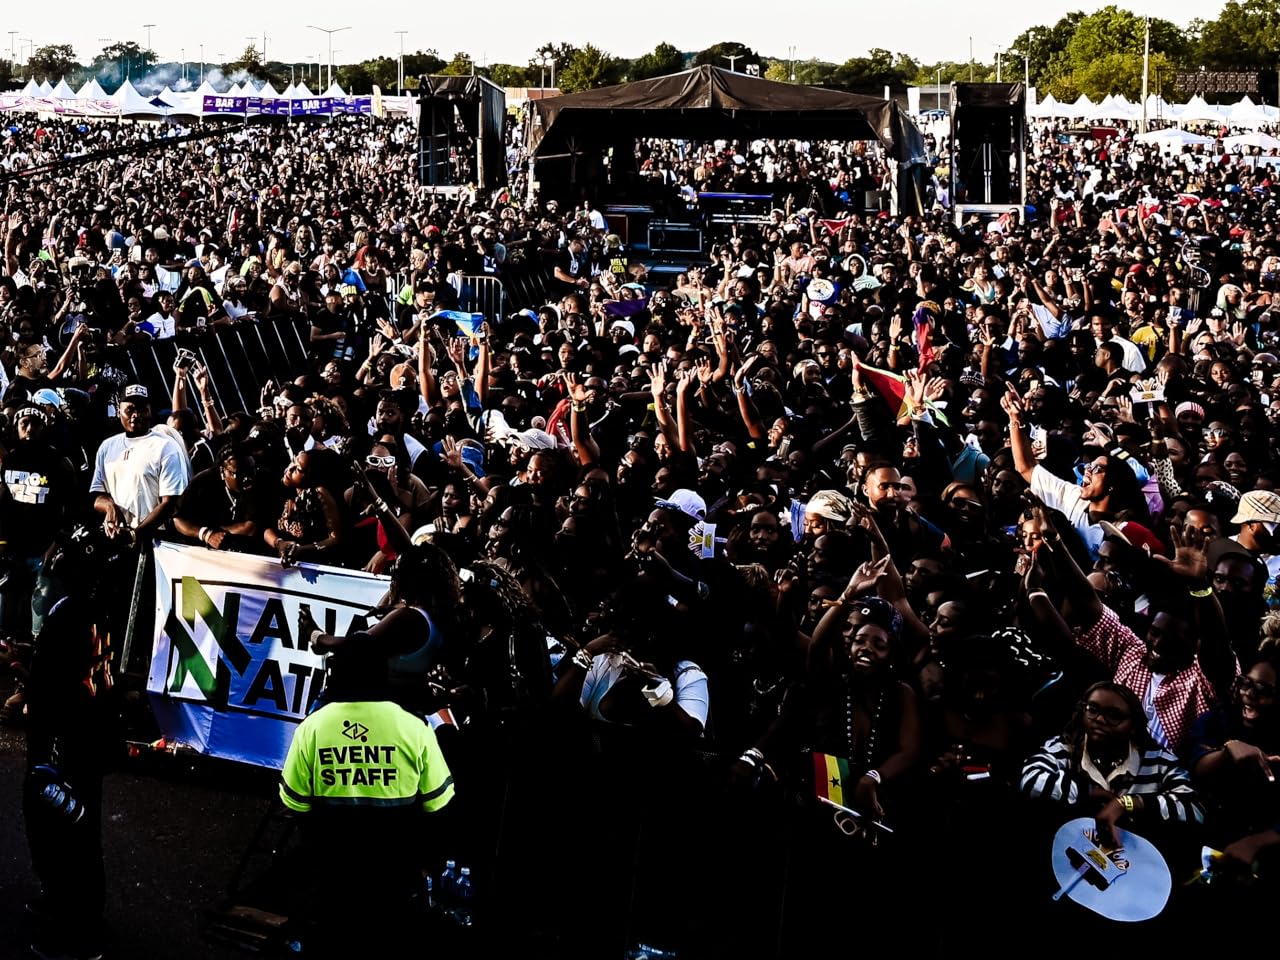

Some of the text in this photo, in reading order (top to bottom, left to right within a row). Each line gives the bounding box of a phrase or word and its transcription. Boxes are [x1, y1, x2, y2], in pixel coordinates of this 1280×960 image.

[215, 97, 234, 108] BAR
[302, 99, 320, 110] BAR
[319, 745, 396, 765] EVENT
[321, 768, 398, 787] STAFF
